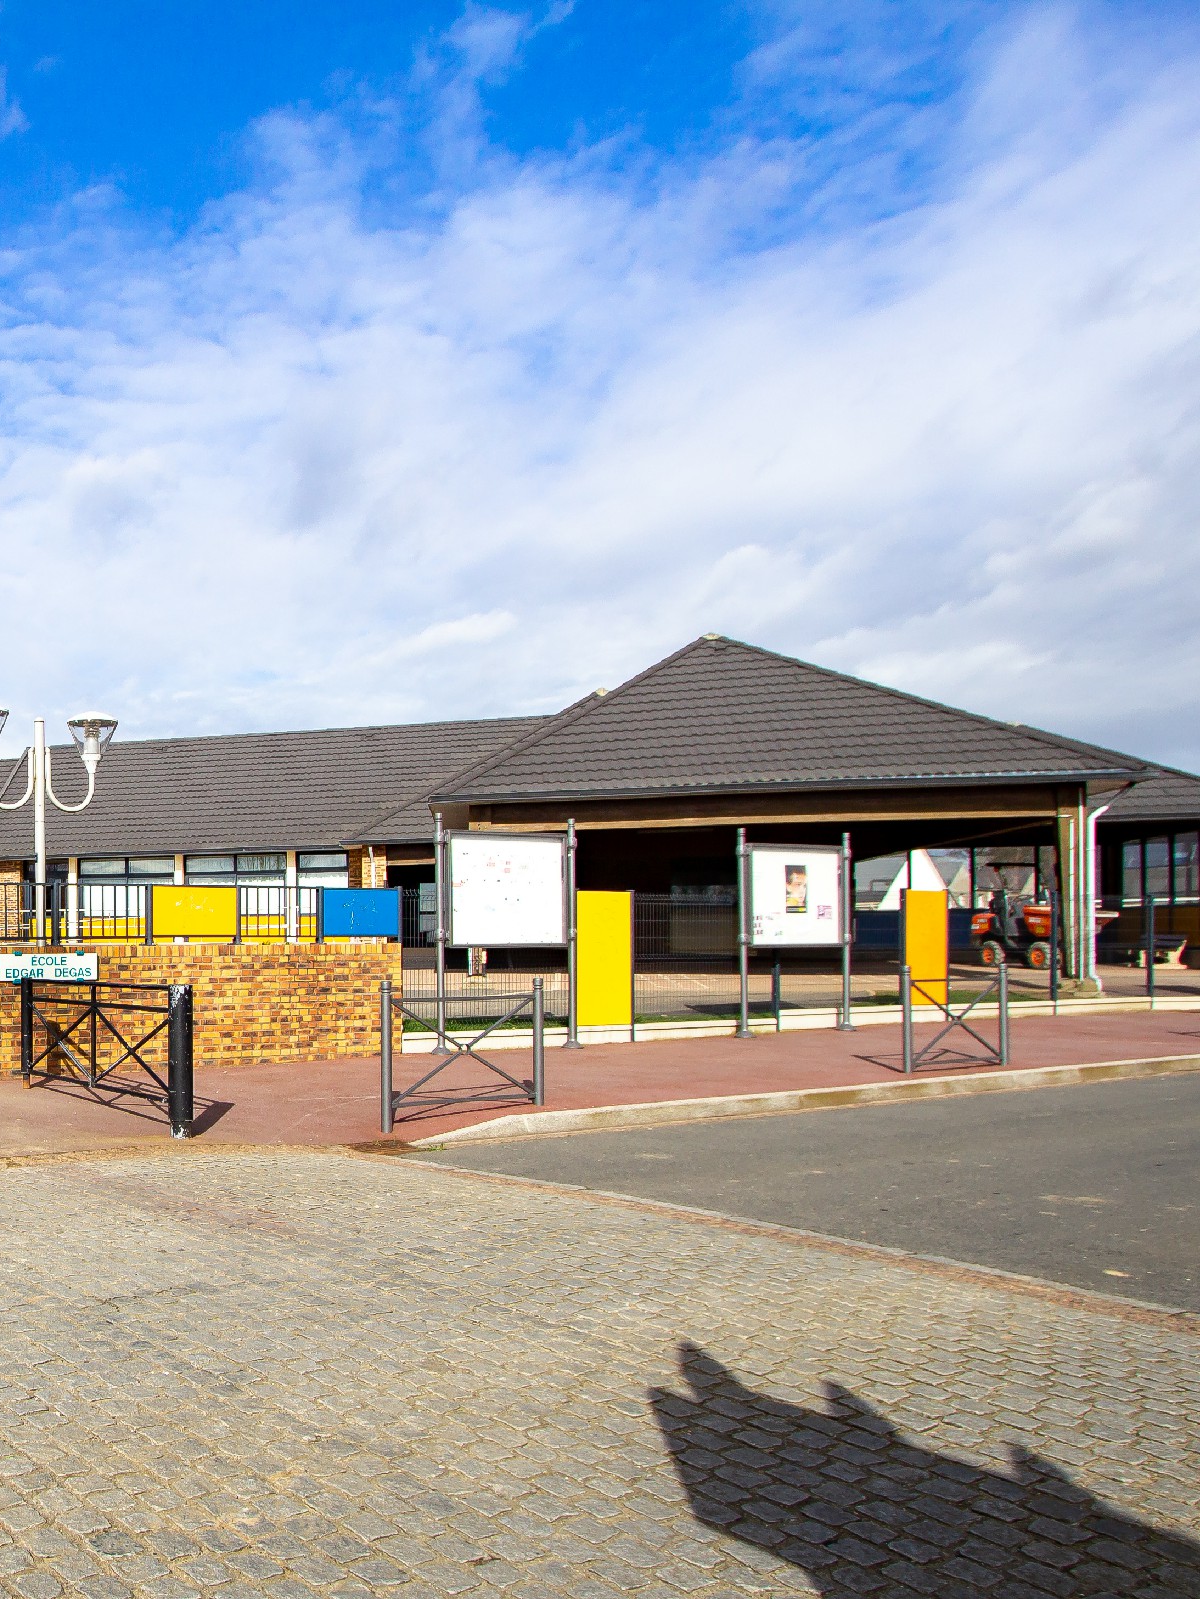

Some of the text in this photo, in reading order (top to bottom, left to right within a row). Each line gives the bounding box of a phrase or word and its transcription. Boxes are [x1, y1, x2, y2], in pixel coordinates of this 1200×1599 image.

[31, 955, 67, 966] ÉCOLE
[5, 967, 92, 978] EDGAR DEGAS
